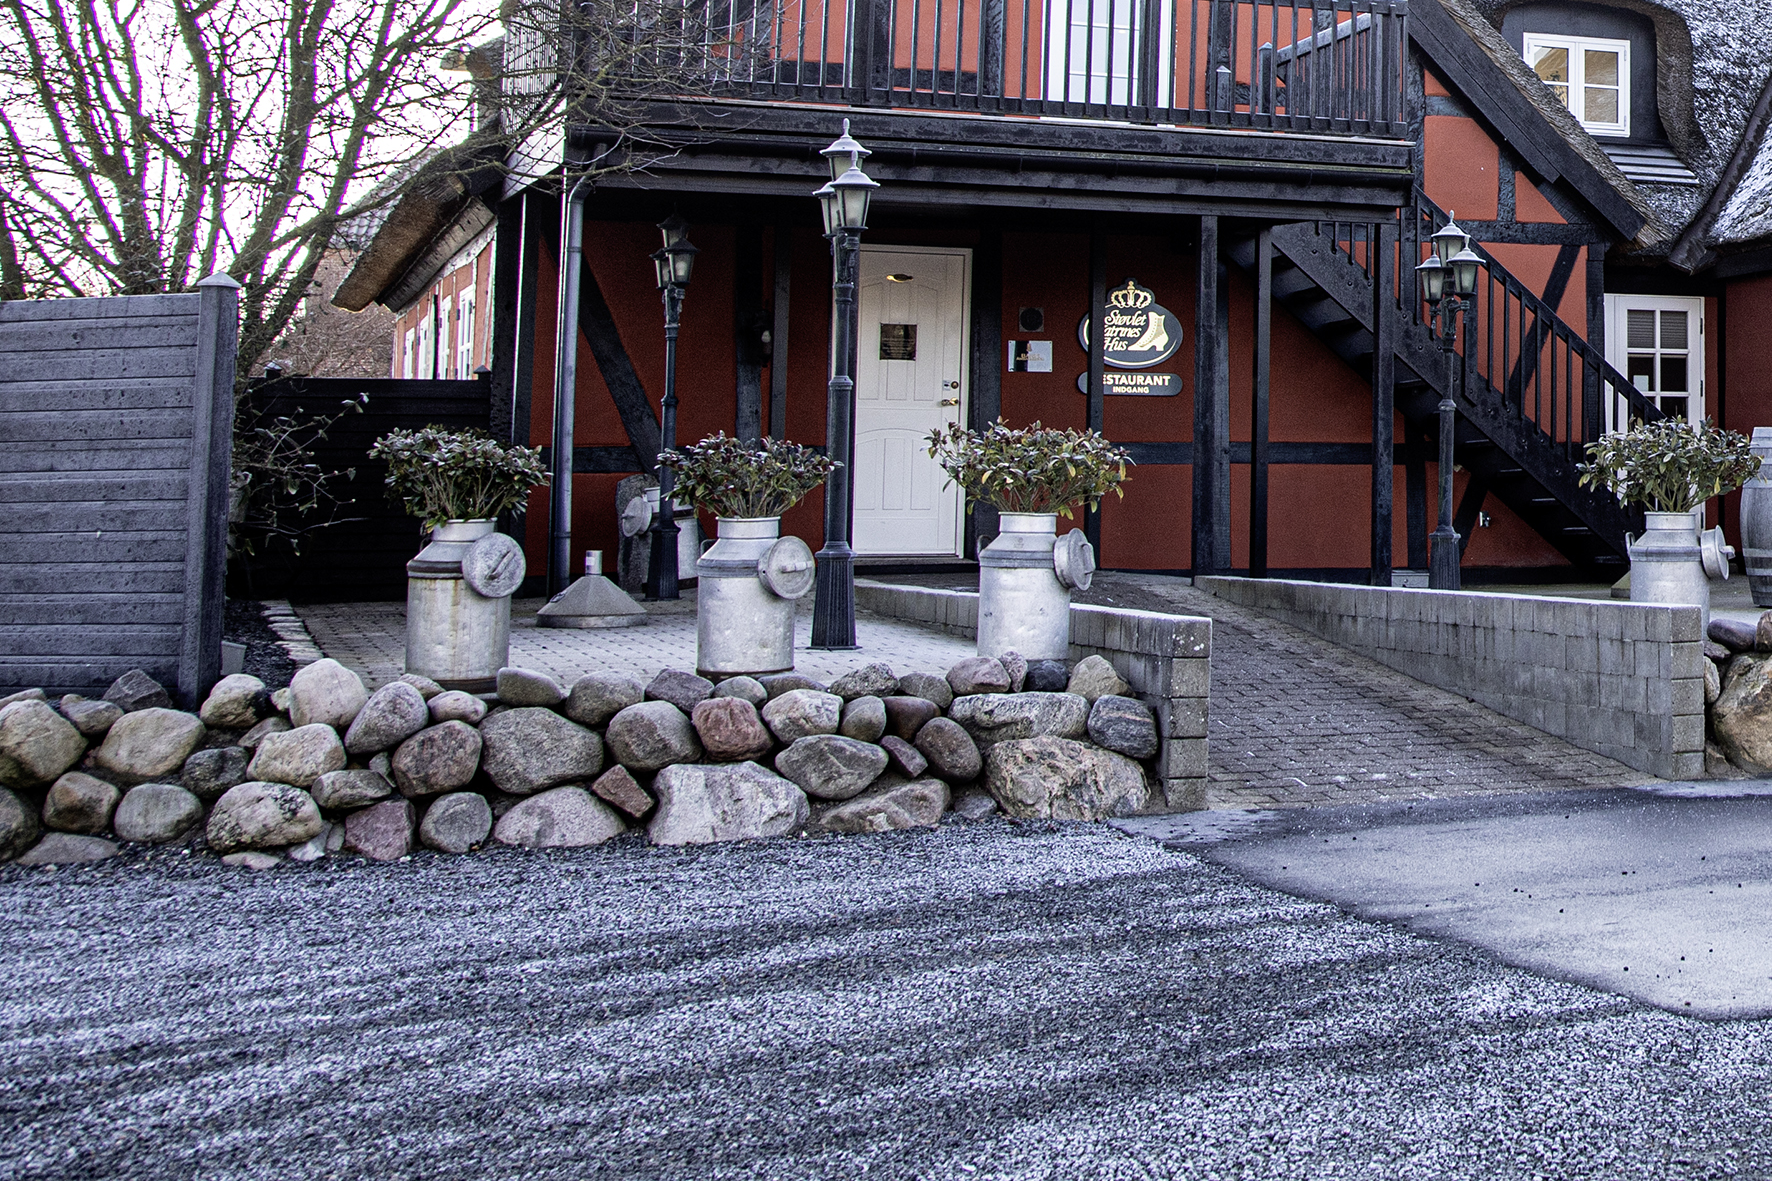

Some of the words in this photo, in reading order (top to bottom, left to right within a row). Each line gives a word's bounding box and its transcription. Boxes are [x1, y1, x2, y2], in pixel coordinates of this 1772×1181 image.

[1104, 309, 1147, 326] Støvlet
[1104, 324, 1142, 338] atrines
[1104, 337, 1128, 351] Hus
[1103, 374, 1171, 386] STAURANT
[1112, 386, 1150, 394] INDGANG
